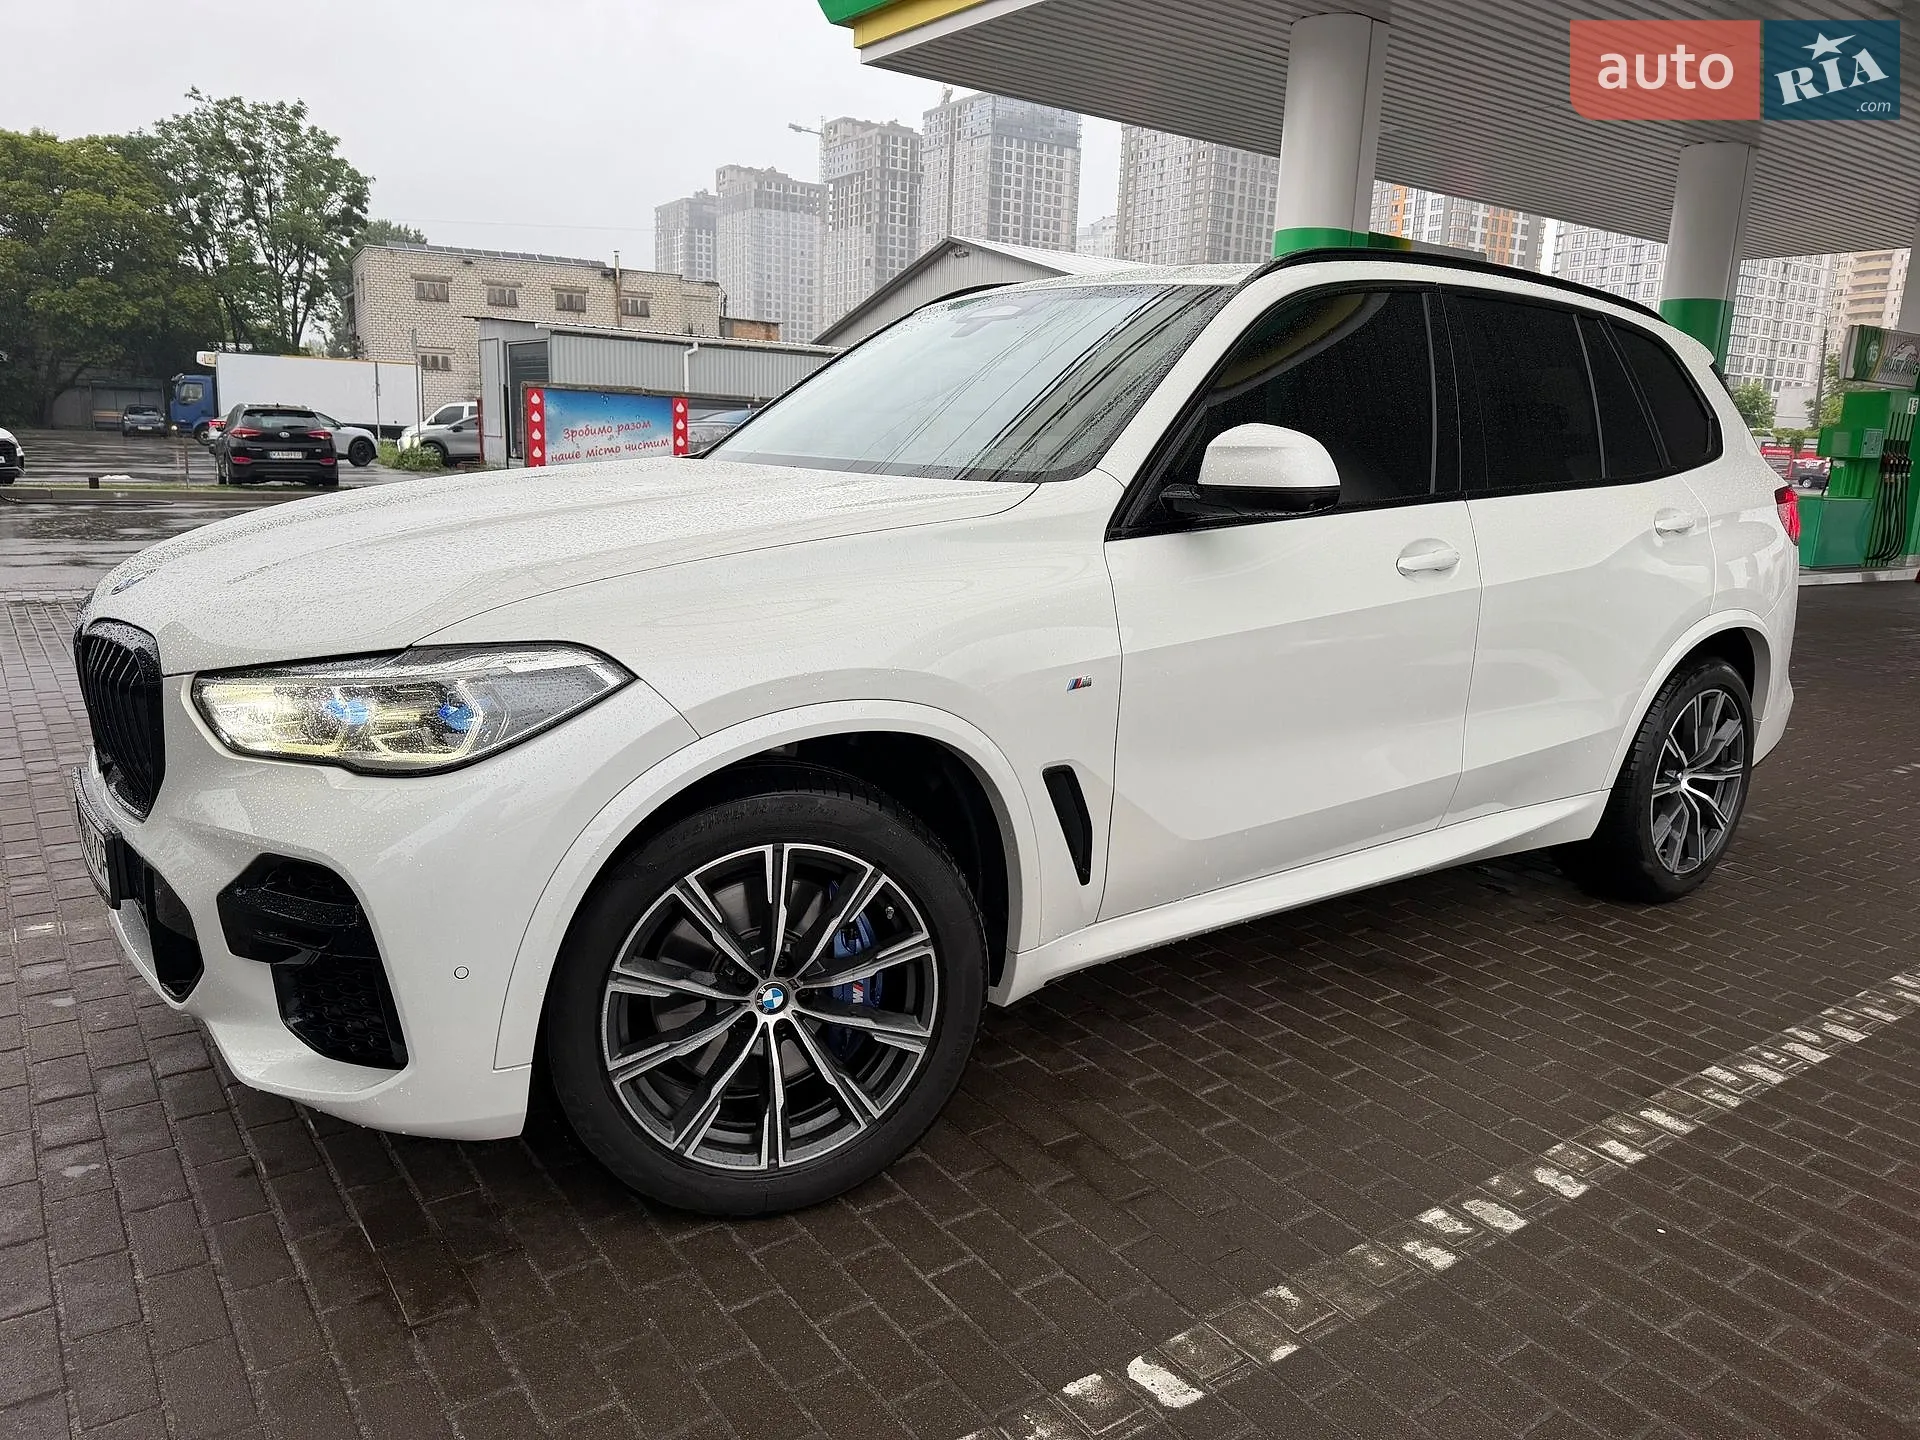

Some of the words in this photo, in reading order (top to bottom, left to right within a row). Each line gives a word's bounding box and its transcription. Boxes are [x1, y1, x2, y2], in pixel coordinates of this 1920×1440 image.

[563, 424, 613, 442] Зробимо
[617, 420, 652, 435] разом
[551, 449, 581, 462] наше
[586, 445, 621, 458] місто
[625, 438, 670, 452] чистим
